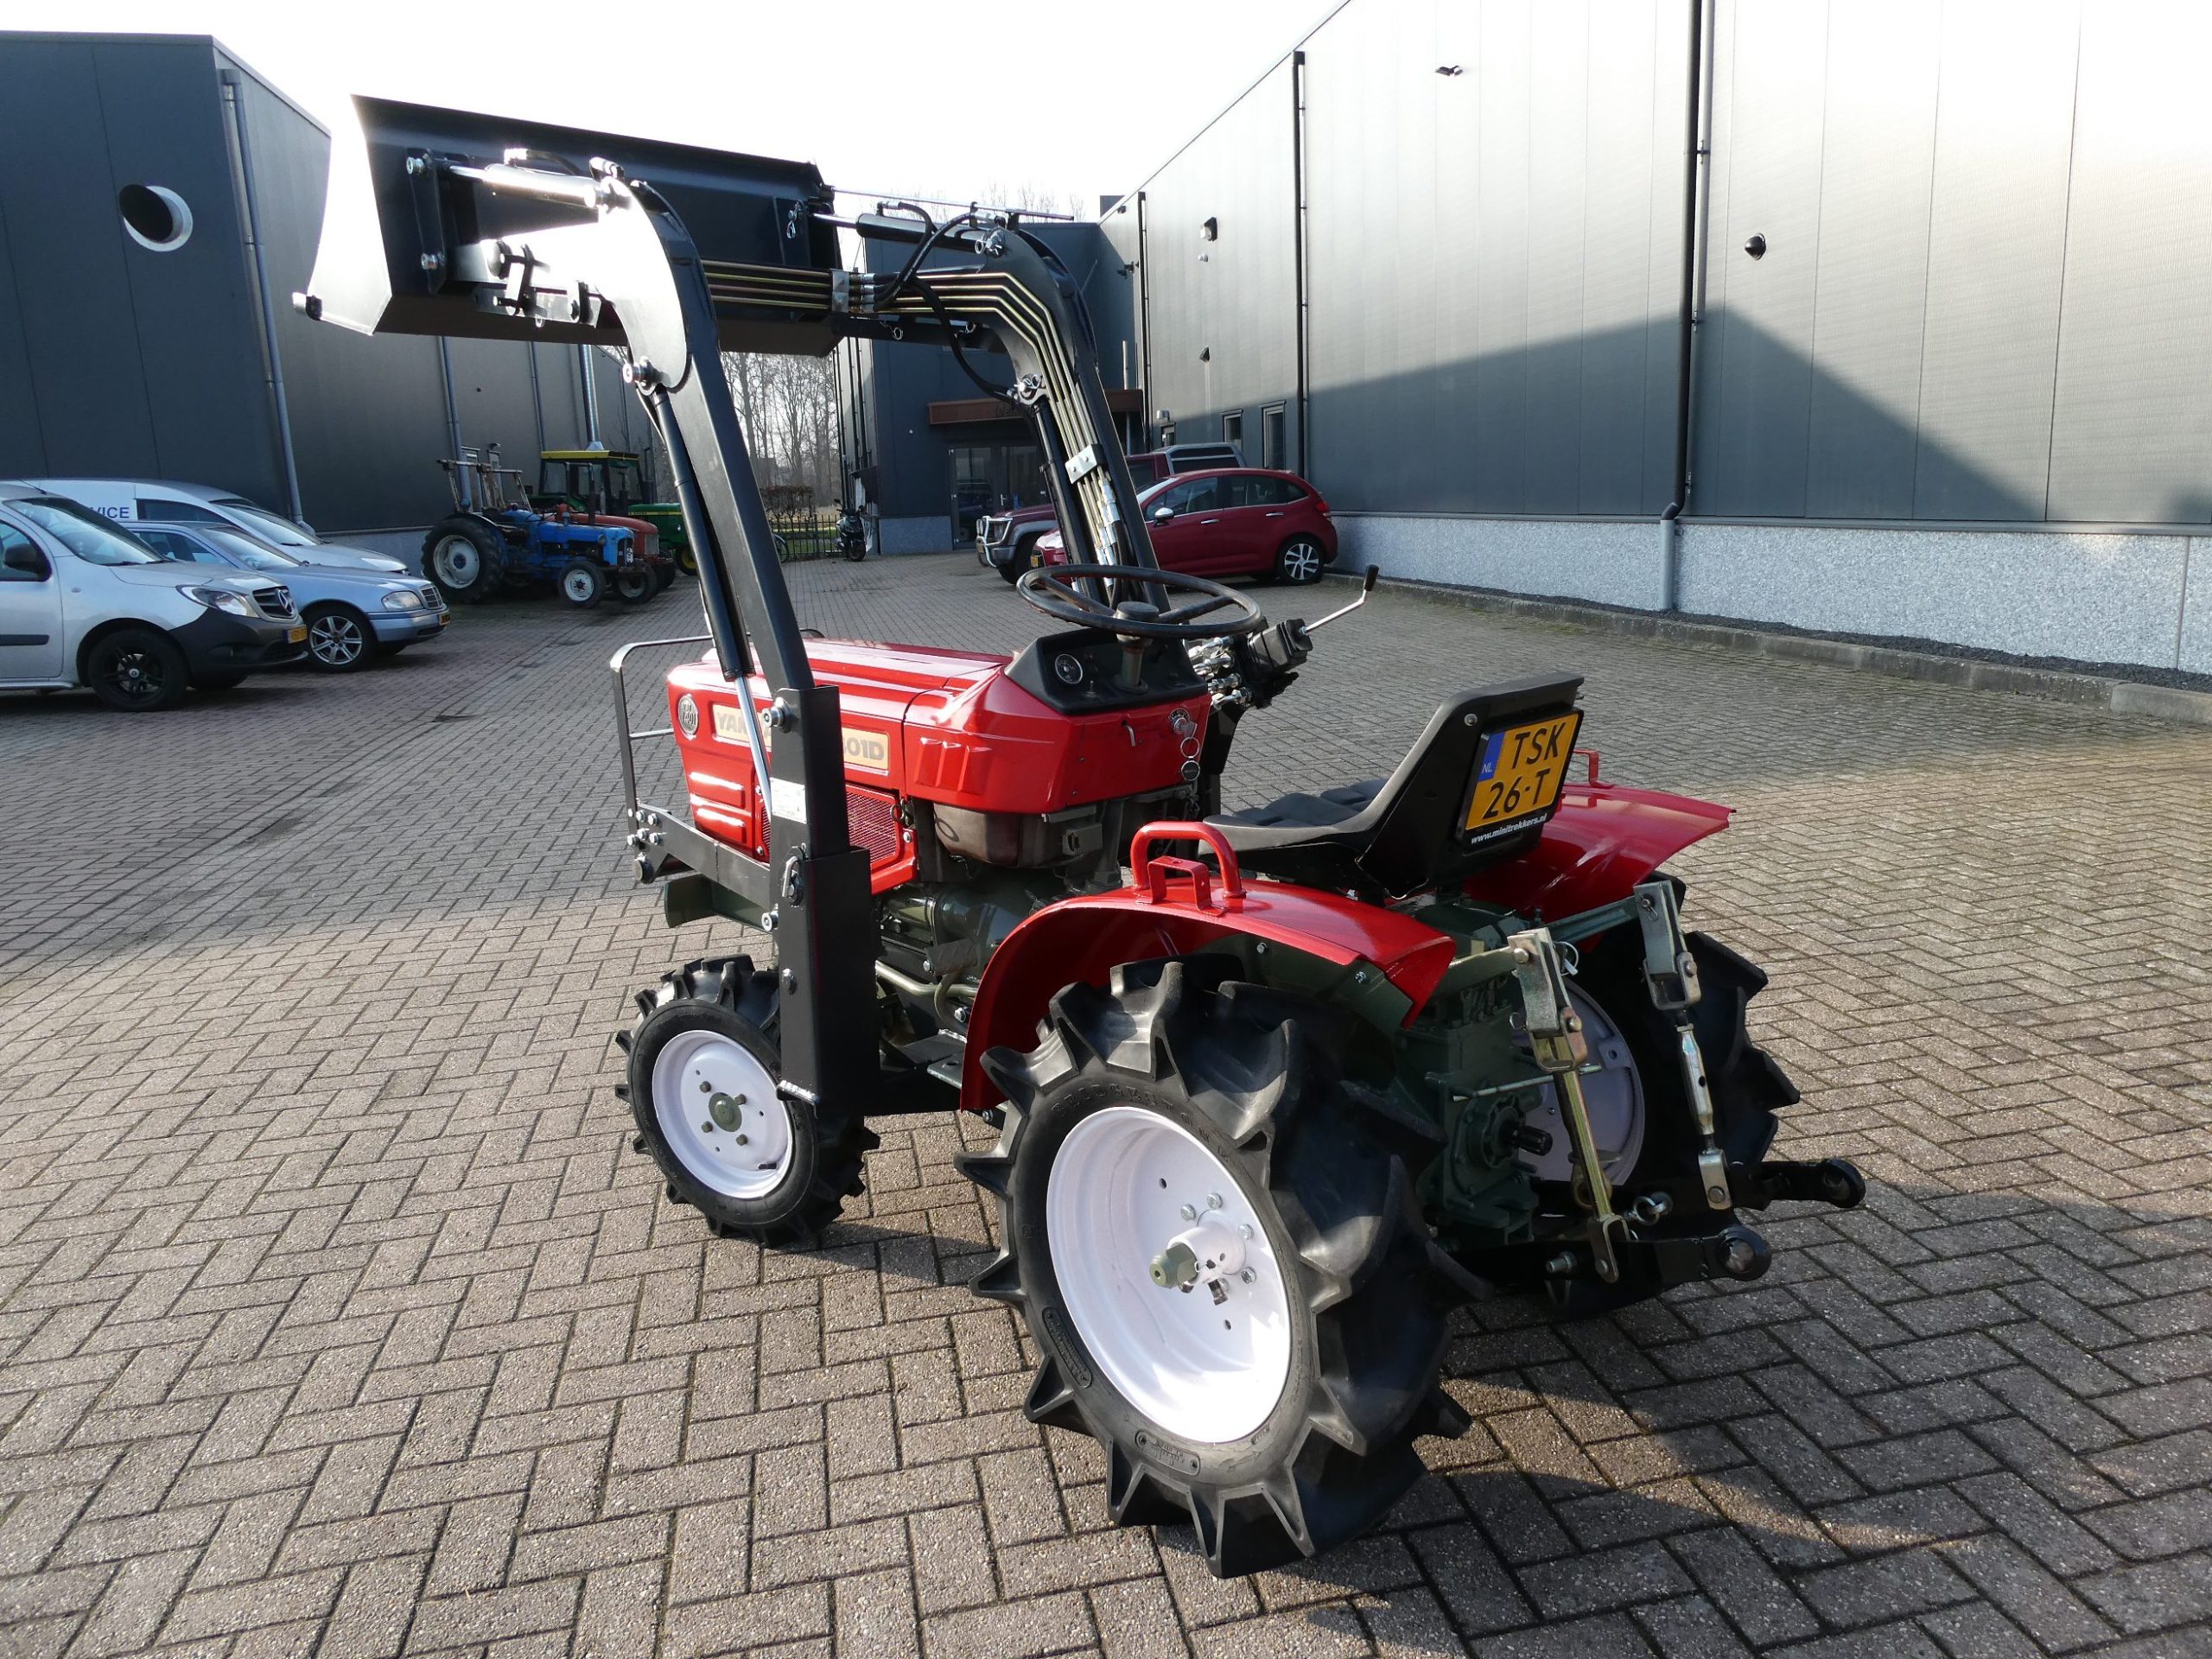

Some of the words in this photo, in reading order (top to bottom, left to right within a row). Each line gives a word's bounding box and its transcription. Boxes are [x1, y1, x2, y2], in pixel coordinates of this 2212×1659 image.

[843, 737, 884, 760] 01D
[1511, 722, 1566, 769] TSK
[1482, 762, 1492, 774] NL
[1482, 767, 1550, 820] 26-T
[1471, 812, 1548, 844] www.minitrekkers.nl
